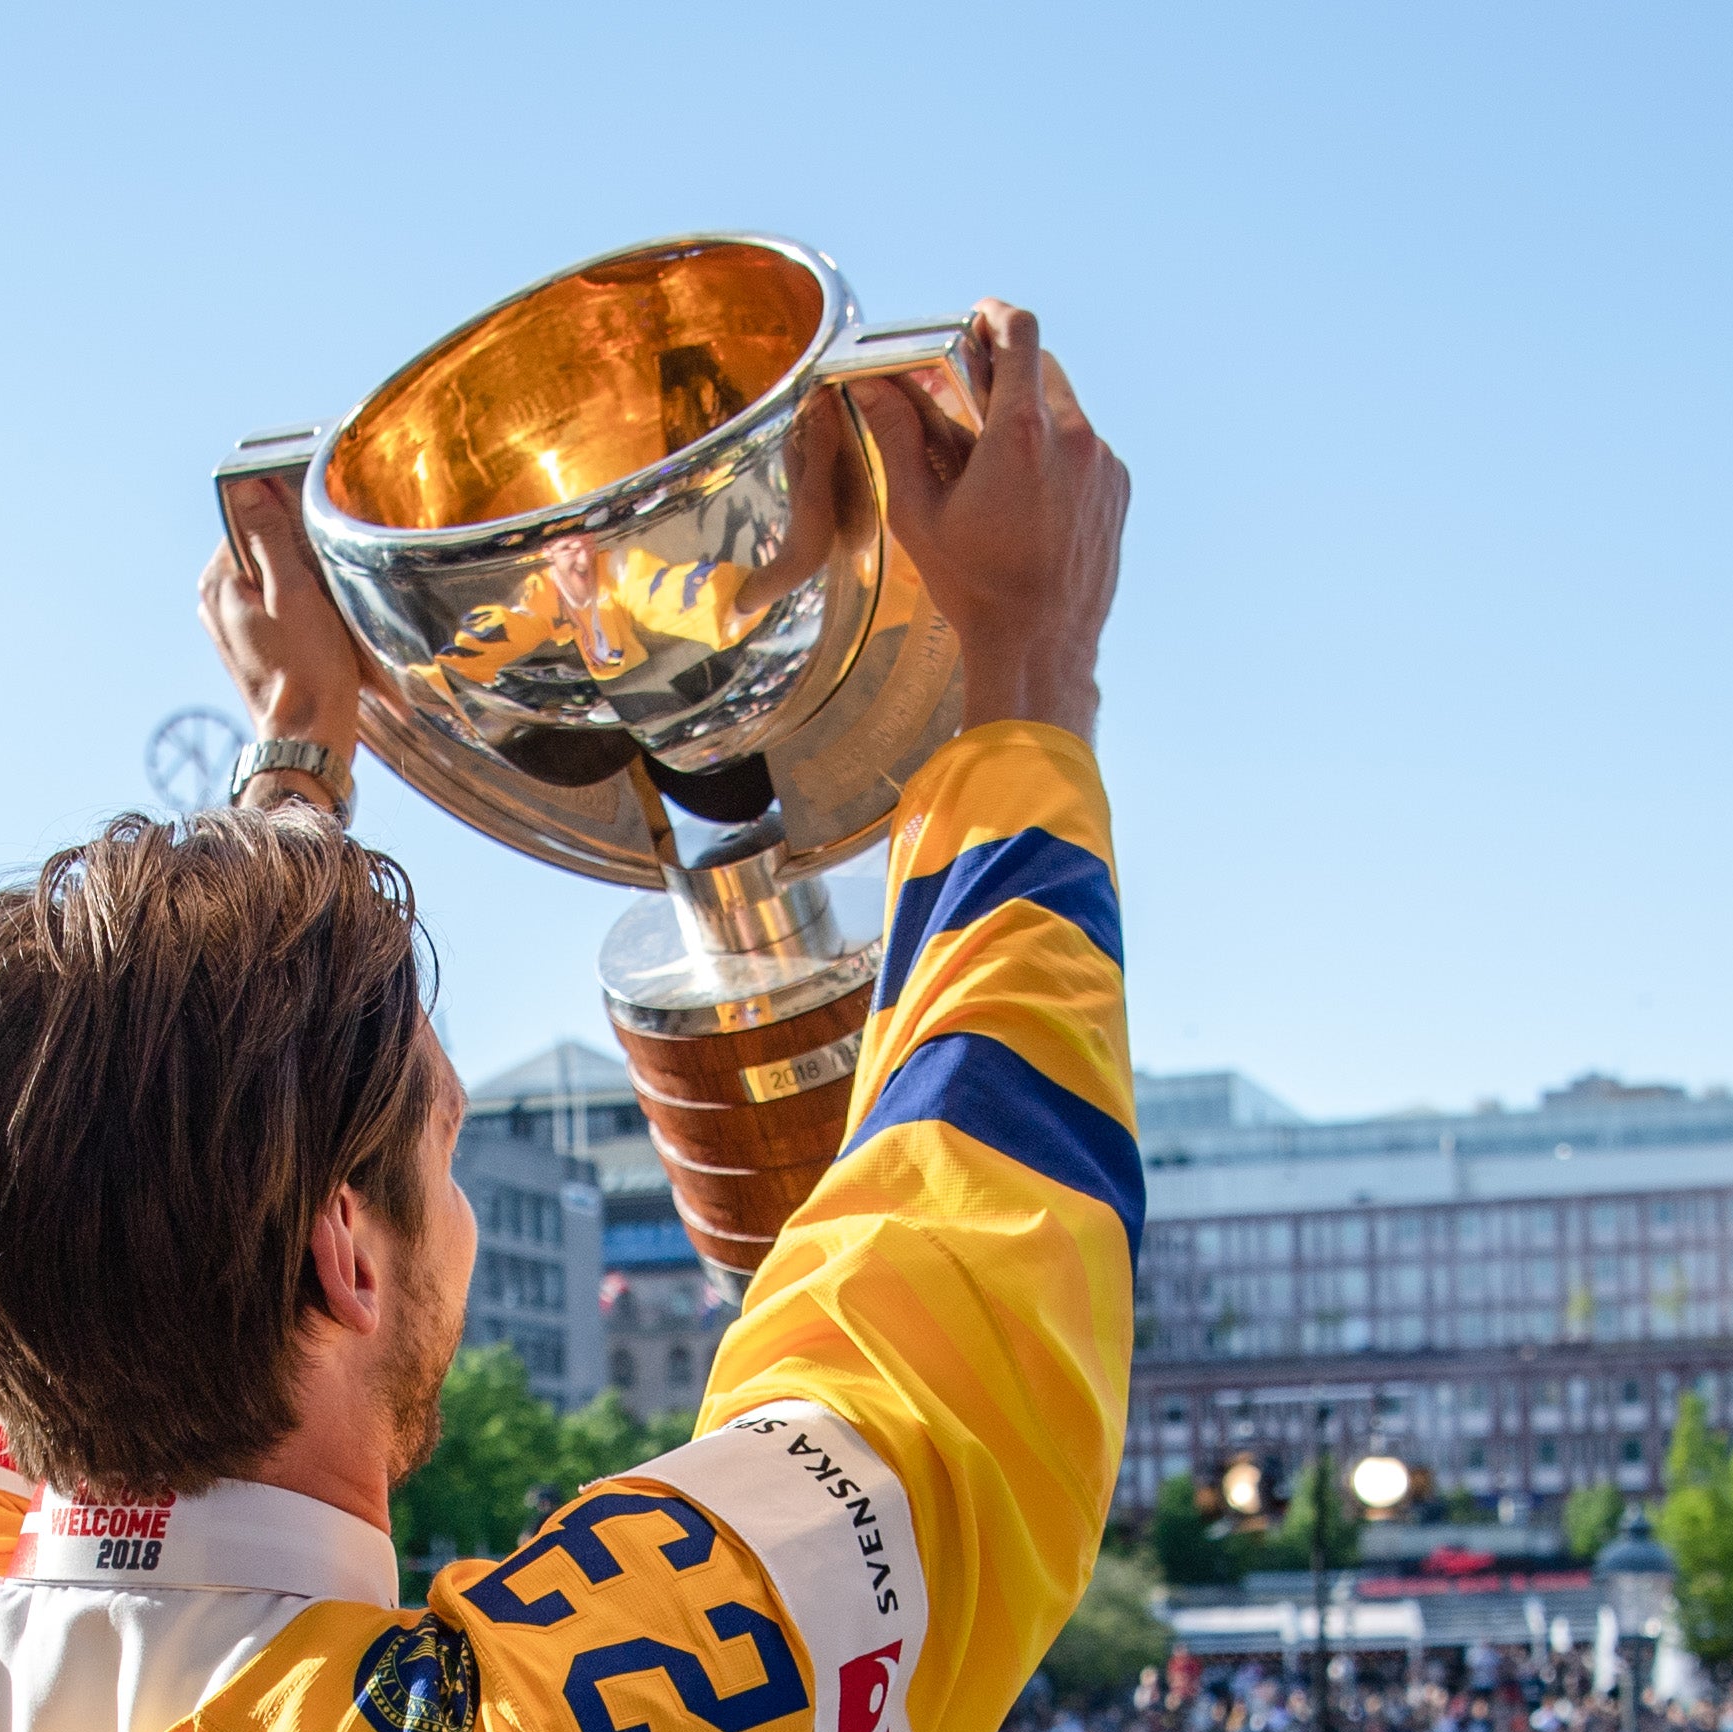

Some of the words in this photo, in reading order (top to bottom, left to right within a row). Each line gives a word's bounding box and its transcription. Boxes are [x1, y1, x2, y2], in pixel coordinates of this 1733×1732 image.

[868, 682, 927, 747] WORLD
[770, 1060, 820, 1090] 2018
[51, 1508, 171, 1539] WELCOME
[786, 1433, 899, 1615] SVENSKA
[96, 1539, 163, 1571] 2018
